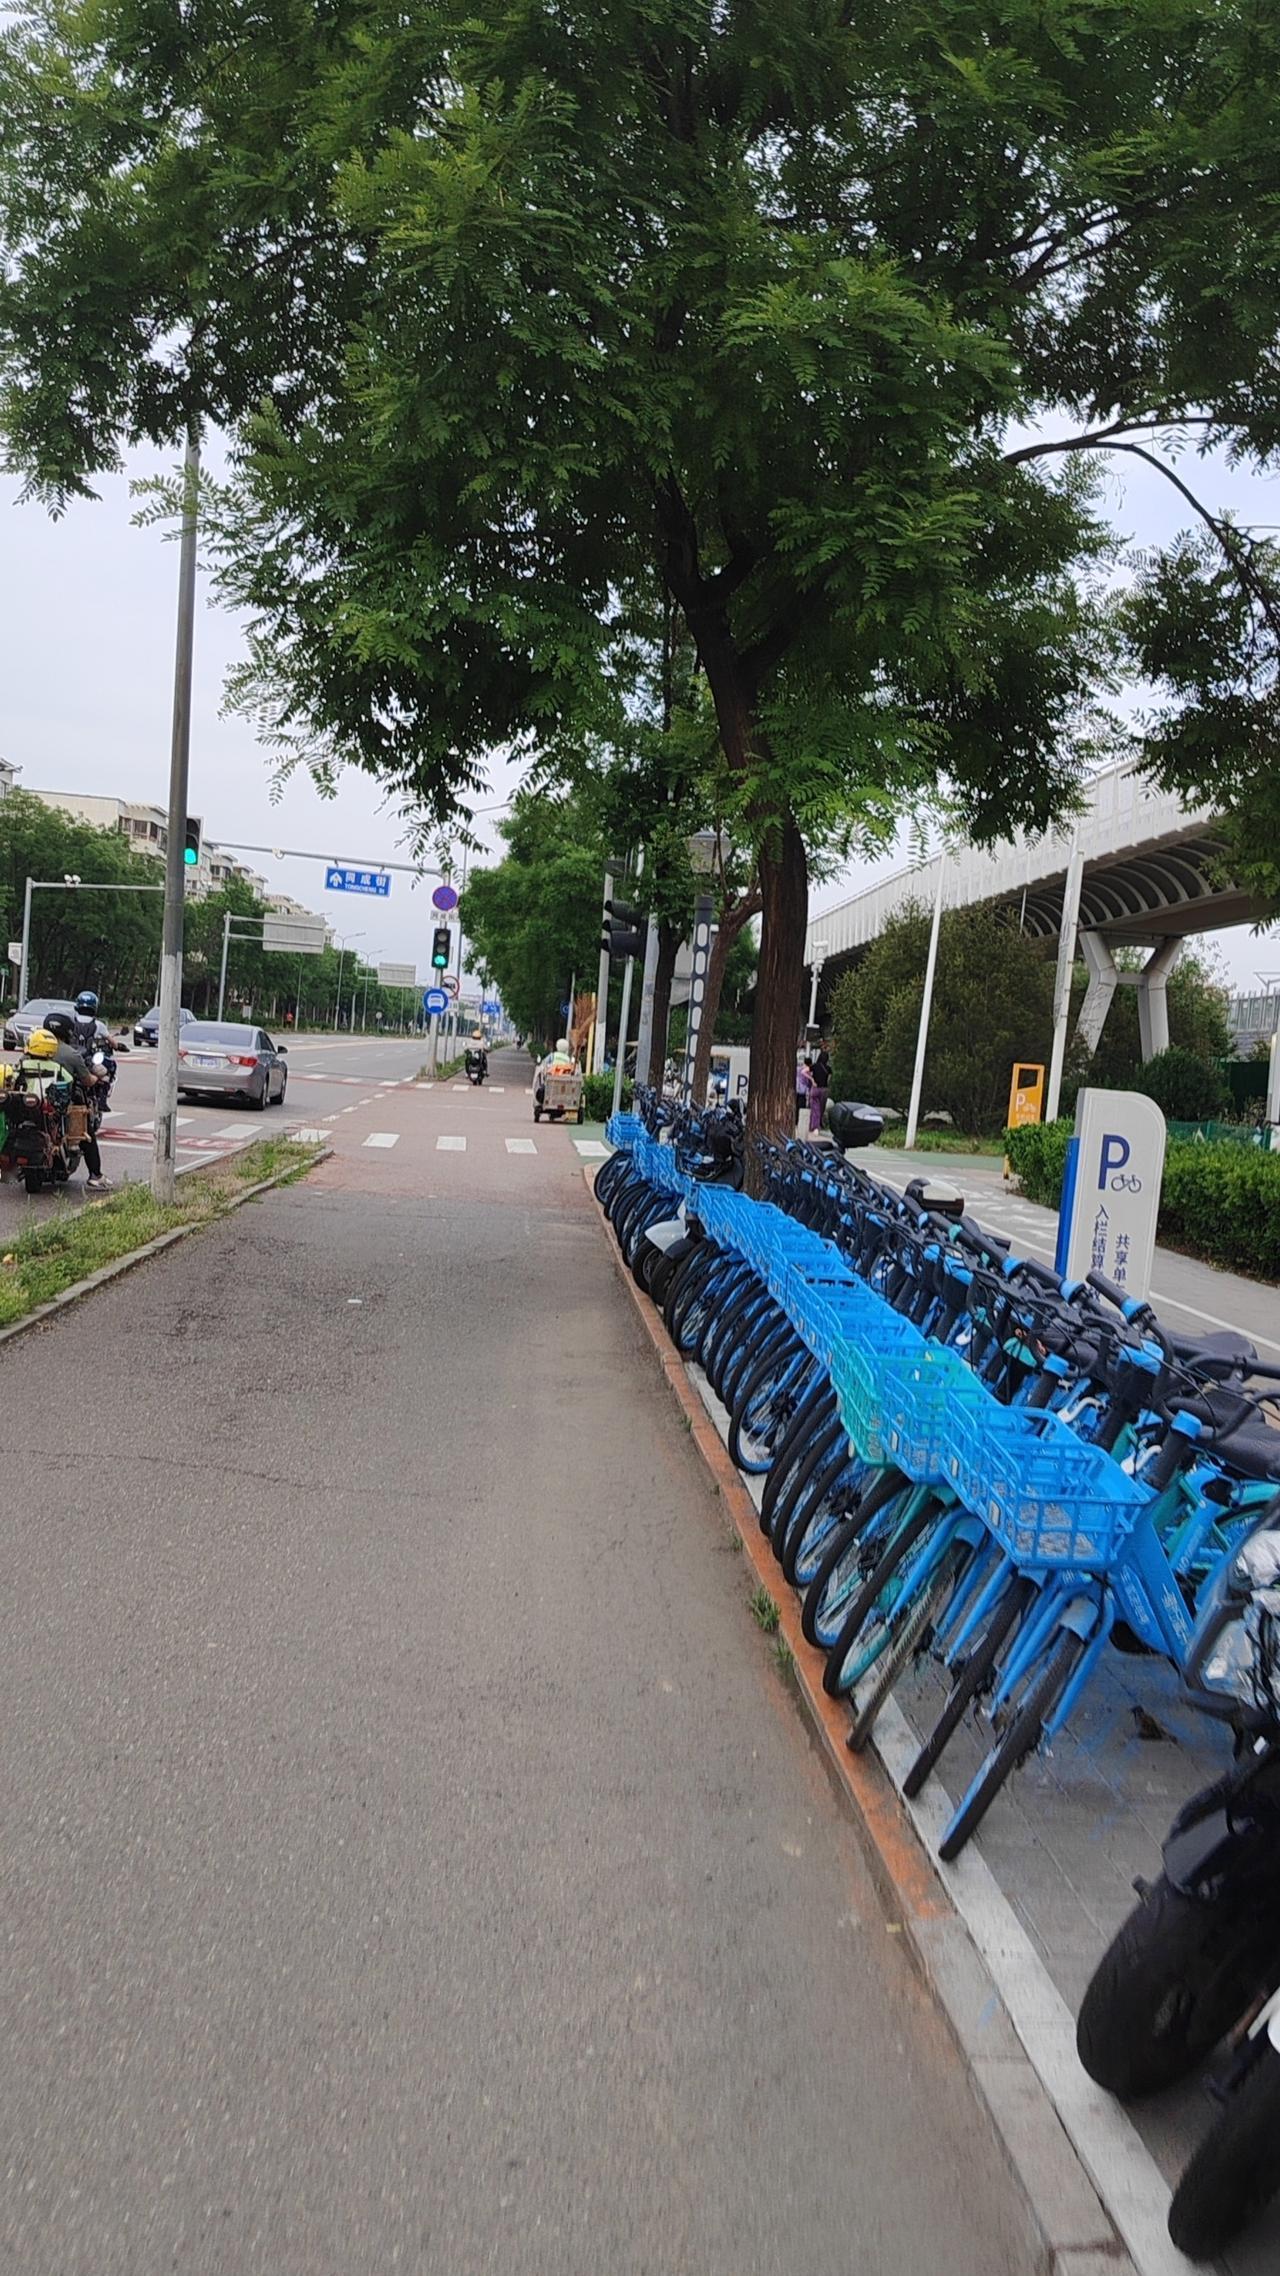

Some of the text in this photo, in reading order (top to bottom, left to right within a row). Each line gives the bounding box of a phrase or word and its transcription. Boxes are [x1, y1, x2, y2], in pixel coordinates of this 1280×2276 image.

[736, 1074, 748, 1096] P
[1016, 1093, 1026, 1112] P
[1097, 1133, 1131, 1190] P
[1087, 1203, 1109, 1302] 入栏结算
[1112, 1232, 1131, 1289] 共享单
